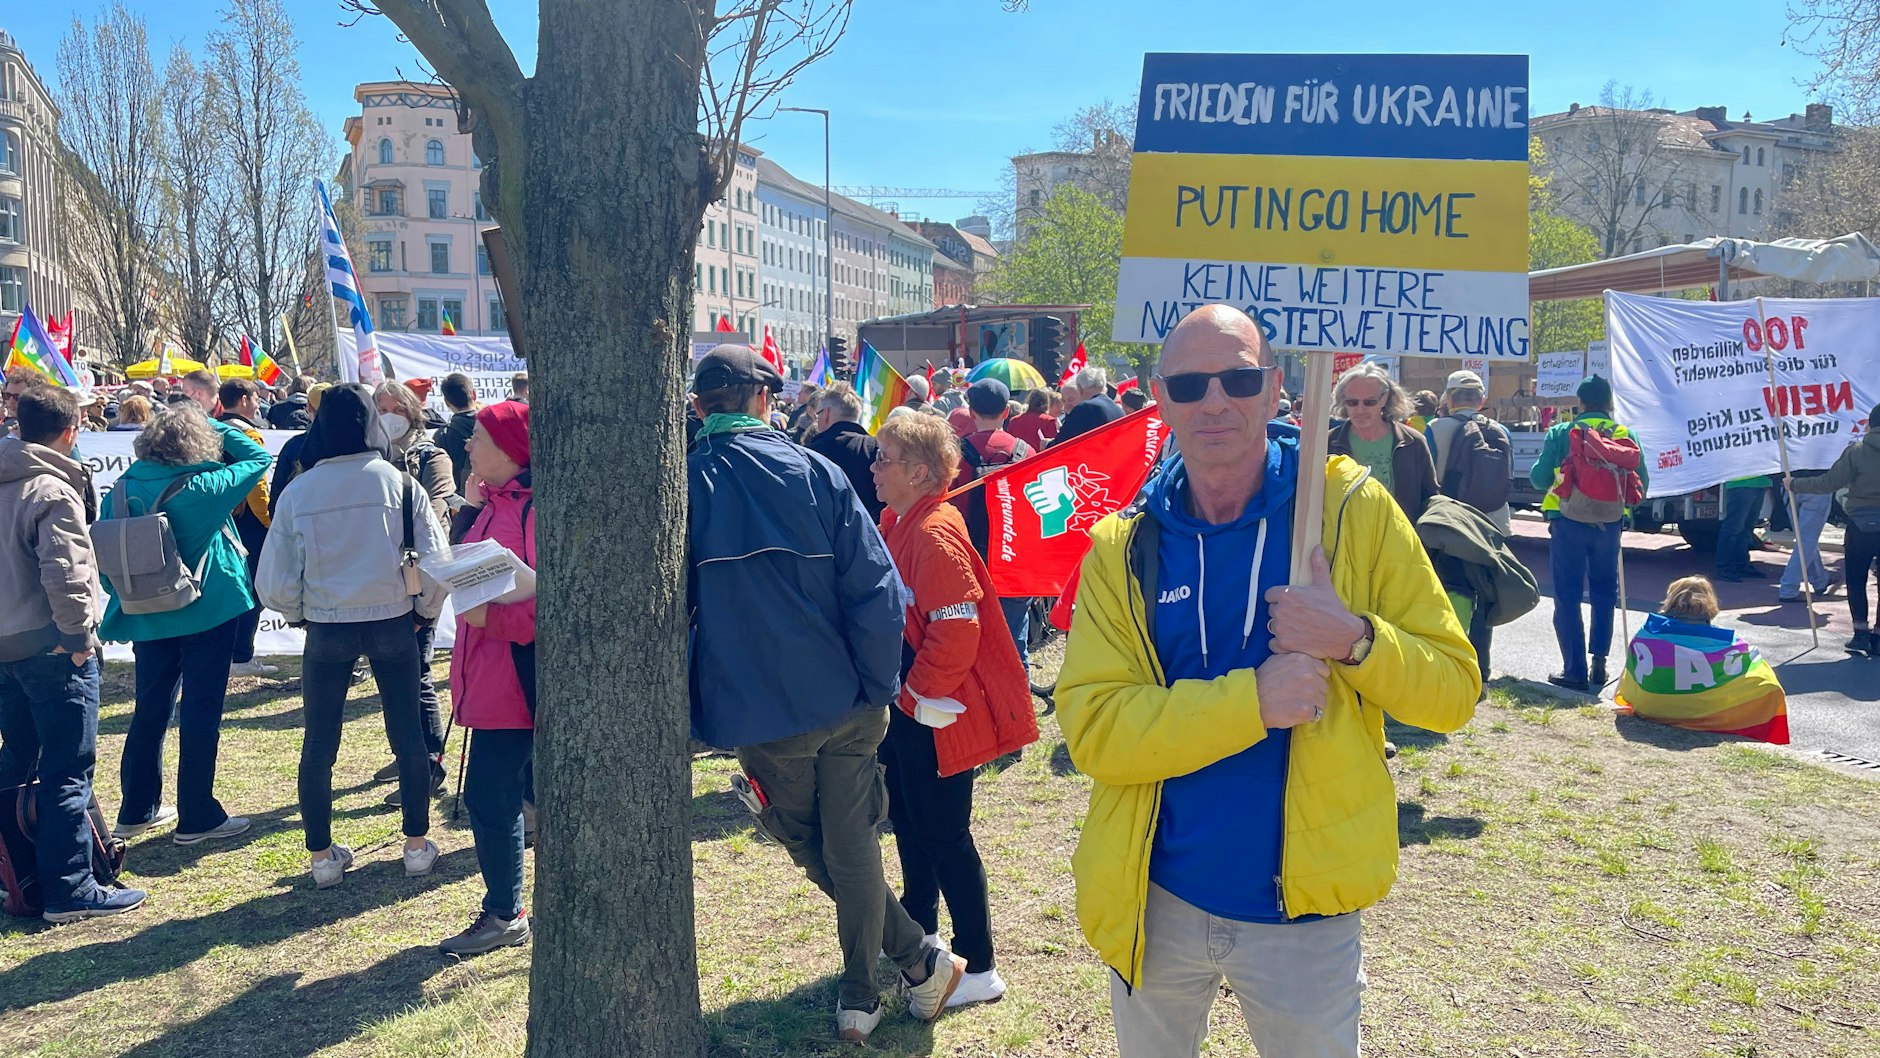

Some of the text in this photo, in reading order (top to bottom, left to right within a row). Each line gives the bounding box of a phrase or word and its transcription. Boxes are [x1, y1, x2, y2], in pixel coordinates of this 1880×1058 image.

[1154, 77, 1528, 129] FRIEDEN FÜR UKRAINE
[1176, 185, 1476, 238] PUTIN GO HOME
[1183, 262, 1444, 310] KEINE WEITERE
[1158, 585, 1191, 604] JAKO
